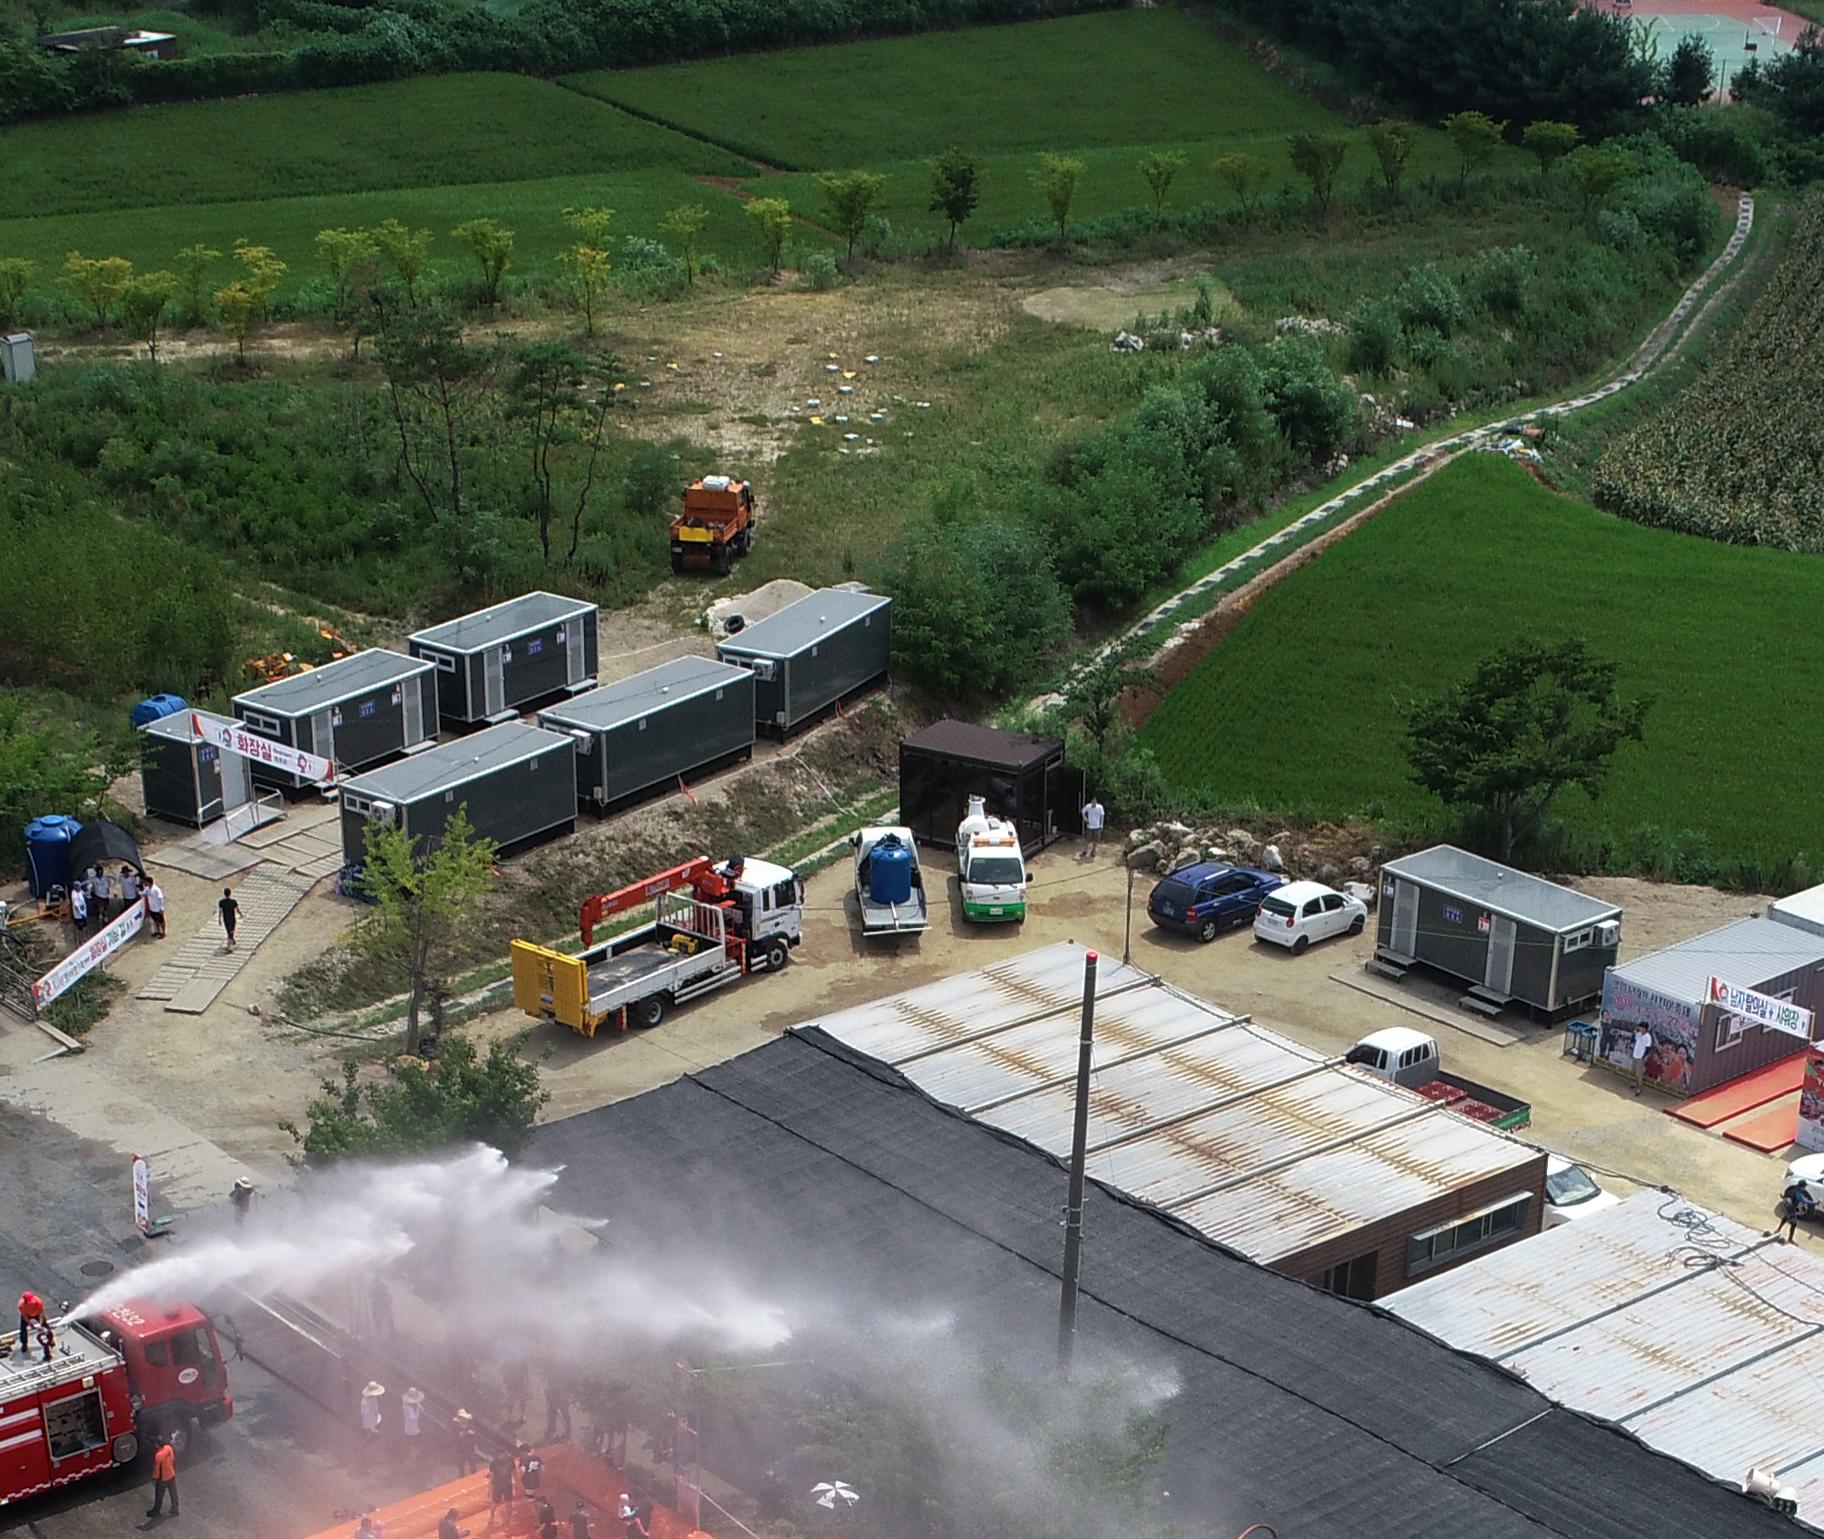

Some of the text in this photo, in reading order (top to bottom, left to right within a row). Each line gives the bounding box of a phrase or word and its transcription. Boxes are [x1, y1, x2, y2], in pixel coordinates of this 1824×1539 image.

[237, 733, 273, 761] 화장실
[1730, 989, 1746, 1010] 남자
[1745, 995, 1769, 1019] 탈의실
[1776, 1004, 1800, 1030] 샤워장
